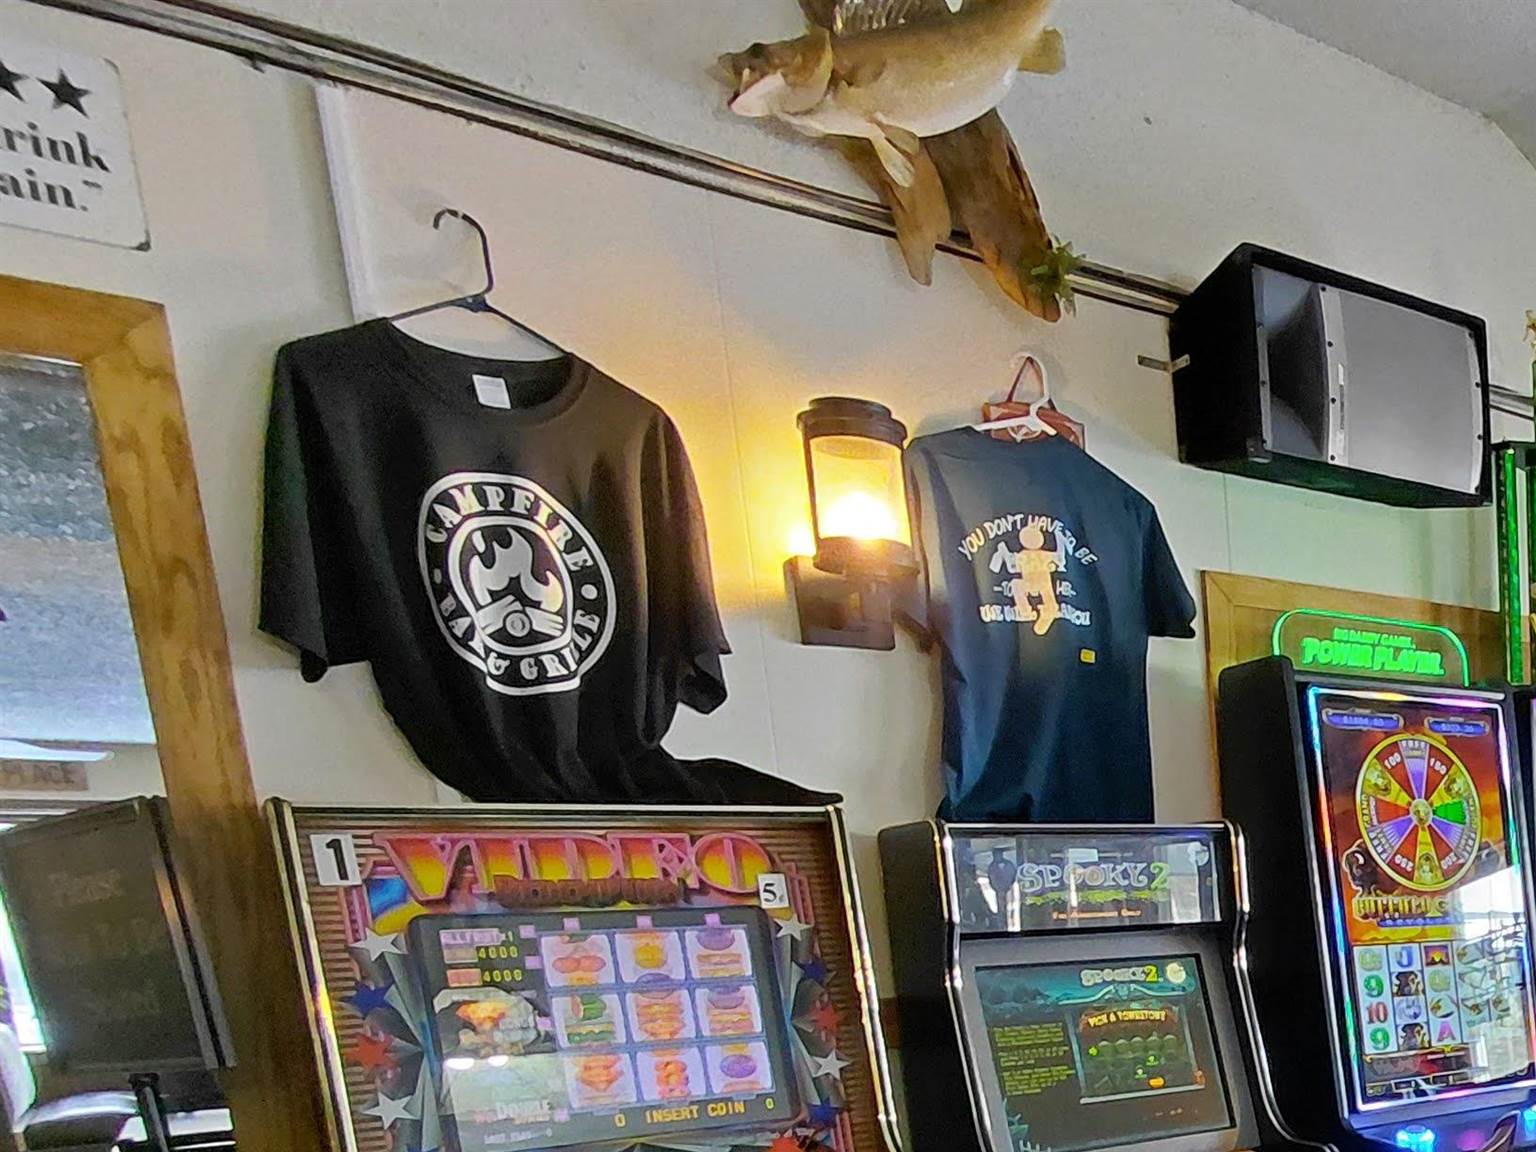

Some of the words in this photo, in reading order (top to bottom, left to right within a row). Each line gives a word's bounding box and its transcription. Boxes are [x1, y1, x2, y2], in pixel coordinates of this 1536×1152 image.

[426, 483, 595, 572] CAMPFIRE
[958, 527, 986, 561] YOU
[1027, 513, 1065, 534] HAVE
[1074, 546, 1099, 566] BE
[325, 837, 351, 882] 1
[373, 832, 776, 901] VIDEO
[1016, 862, 1148, 894] SPOOKY
[1150, 862, 1171, 891] 2
[1363, 974, 1385, 998] 9
[1366, 1001, 1389, 1025] 10
[1369, 1027, 1391, 1051] 9
[645, 1105, 701, 1125] INSERT
[707, 1101, 746, 1118] COIN
